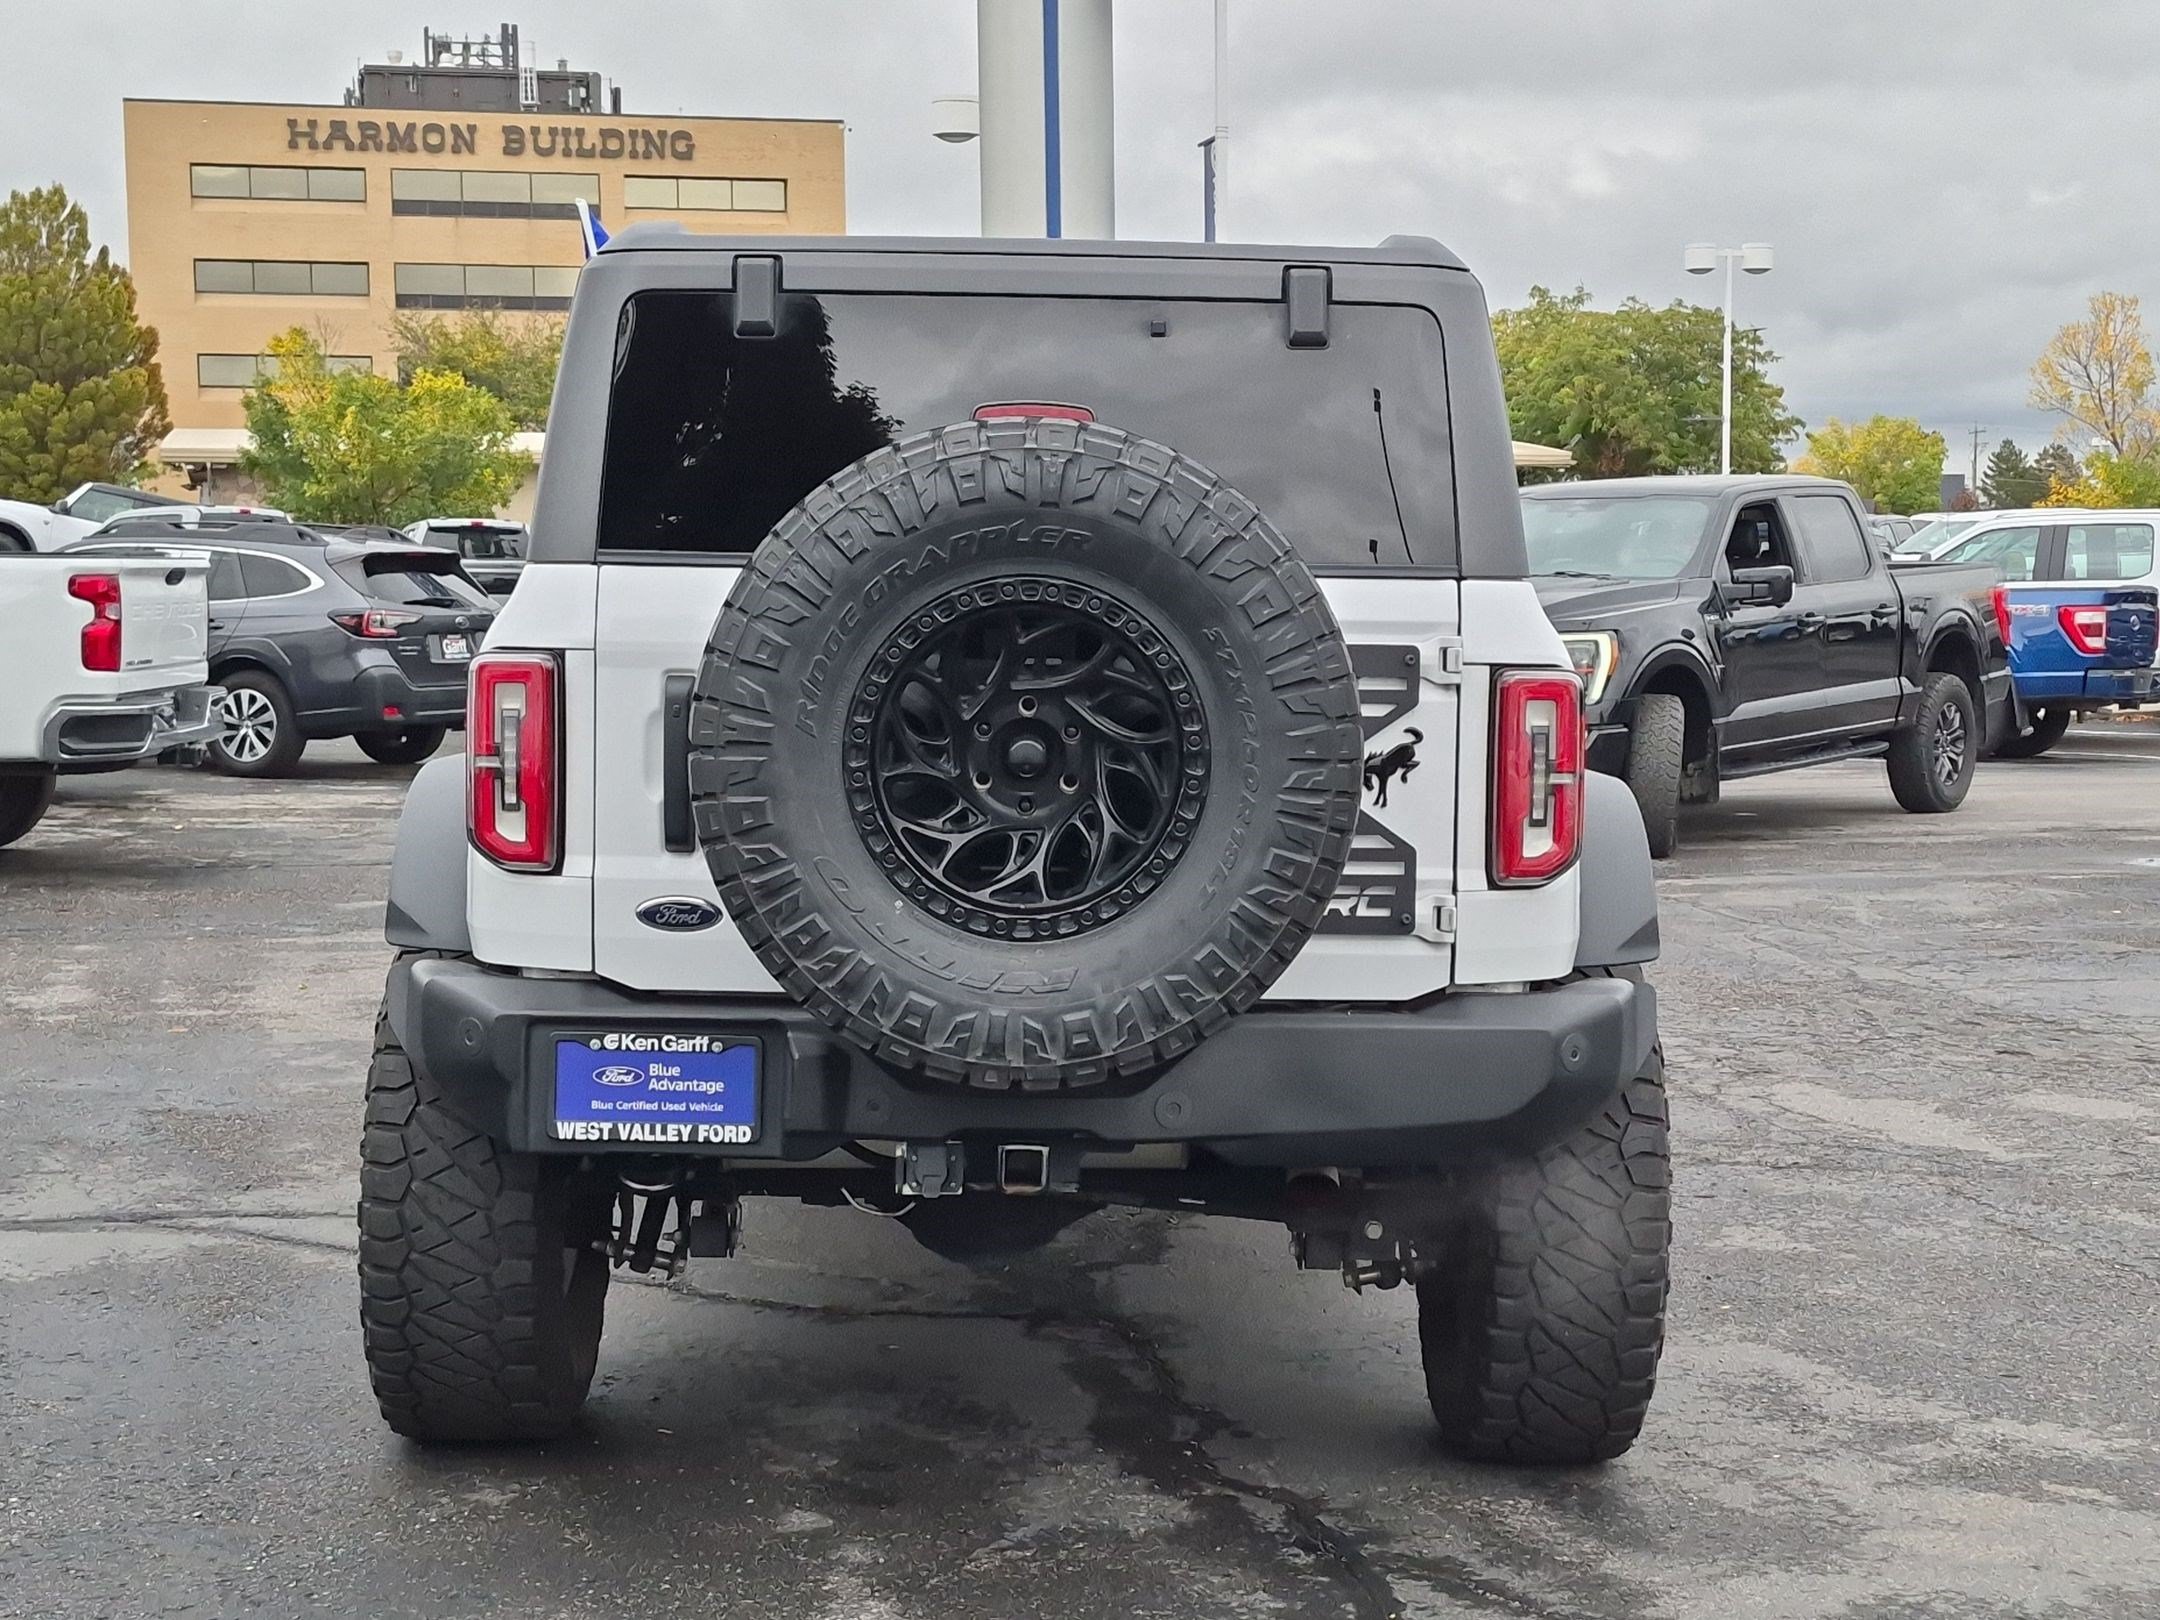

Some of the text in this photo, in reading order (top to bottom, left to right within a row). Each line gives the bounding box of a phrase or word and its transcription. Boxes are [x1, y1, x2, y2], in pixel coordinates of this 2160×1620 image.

[287, 118, 696, 161] HARMON BUILDING
[656, 904, 702, 924] Ford
[622, 1034, 709, 1053] Ken Garff
[602, 1070, 636, 1083] Ford
[649, 1064, 681, 1077] Blue
[648, 1079, 725, 1095] Advantage
[591, 1101, 724, 1112] Blue Certified Used Vehicle
[557, 1122, 752, 1144] WEST VALLEY FORD
